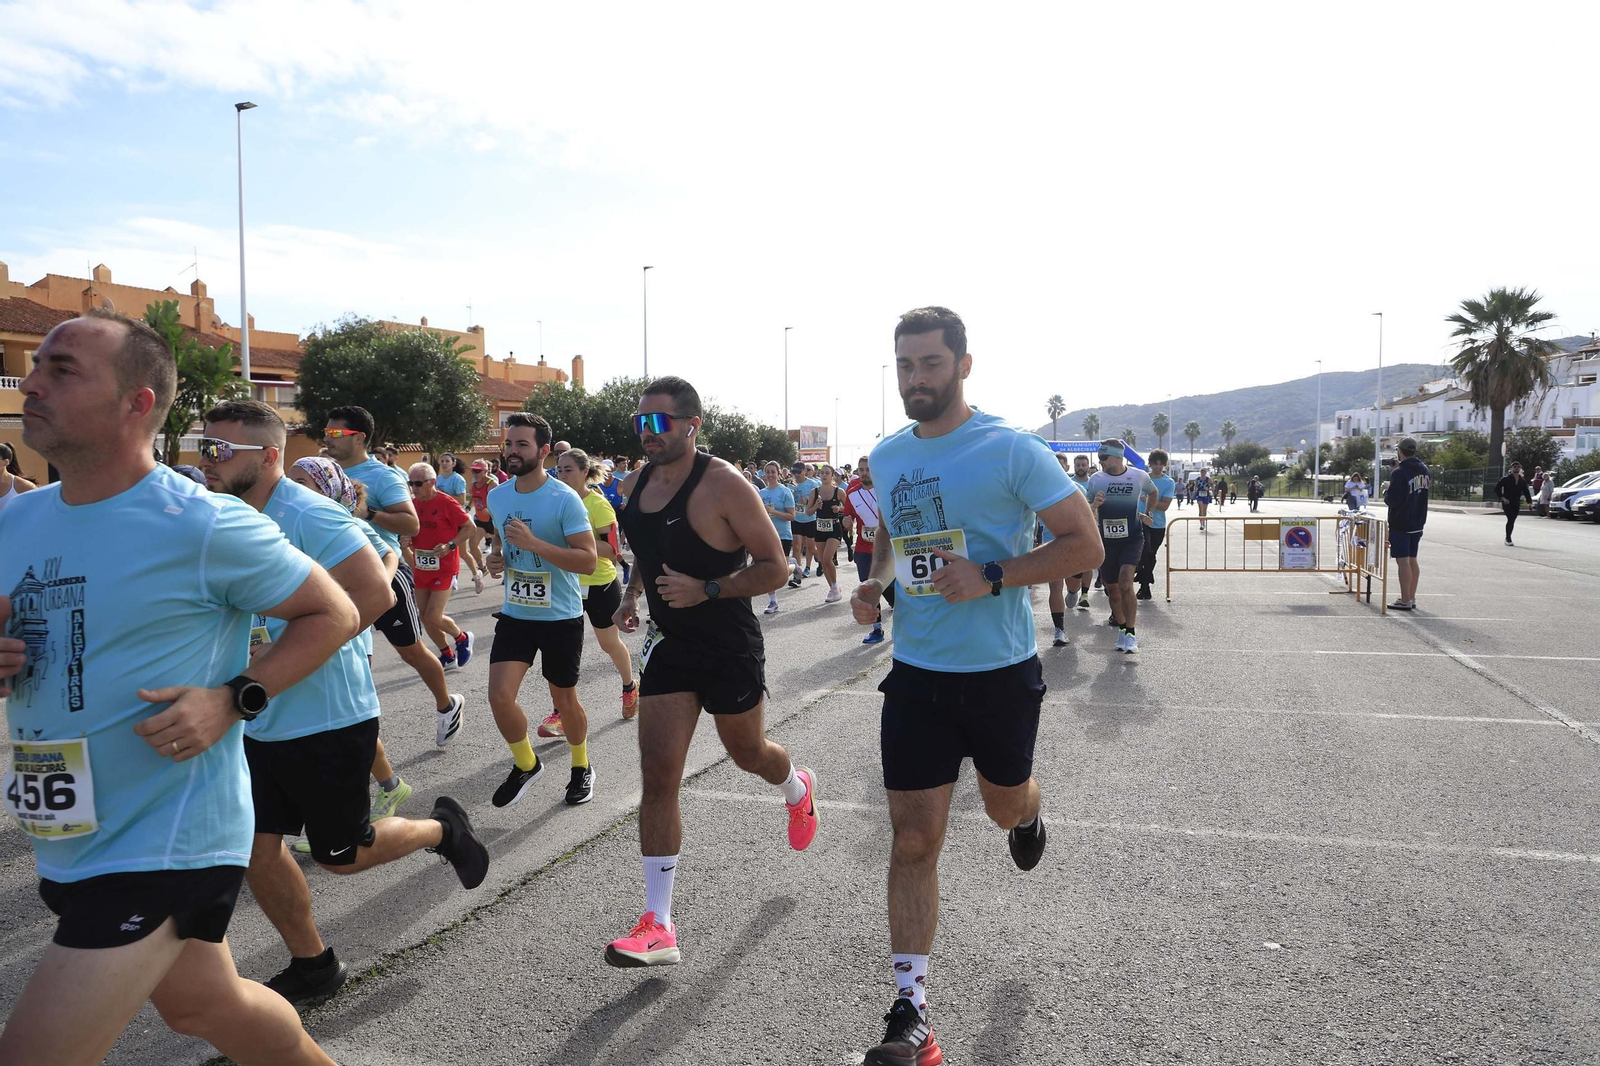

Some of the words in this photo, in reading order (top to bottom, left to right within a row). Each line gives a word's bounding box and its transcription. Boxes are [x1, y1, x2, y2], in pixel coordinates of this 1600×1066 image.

[915, 477, 940, 486] CARRERA
[913, 482, 940, 500] URBANA
[1105, 525, 1126, 533] 103
[903, 541, 926, 549] CARRERA
[927, 537, 952, 546] URBANA
[904, 548, 920, 556] CIUDAD
[416, 556, 437, 565] 136
[42, 556, 62, 582] XXV
[46, 576, 87, 588] CARRERA
[511, 581, 546, 598] 413
[44, 585, 85, 611] URBANA
[69, 610, 85, 710] ALGECIRAS
[7, 773, 76, 811] 456
